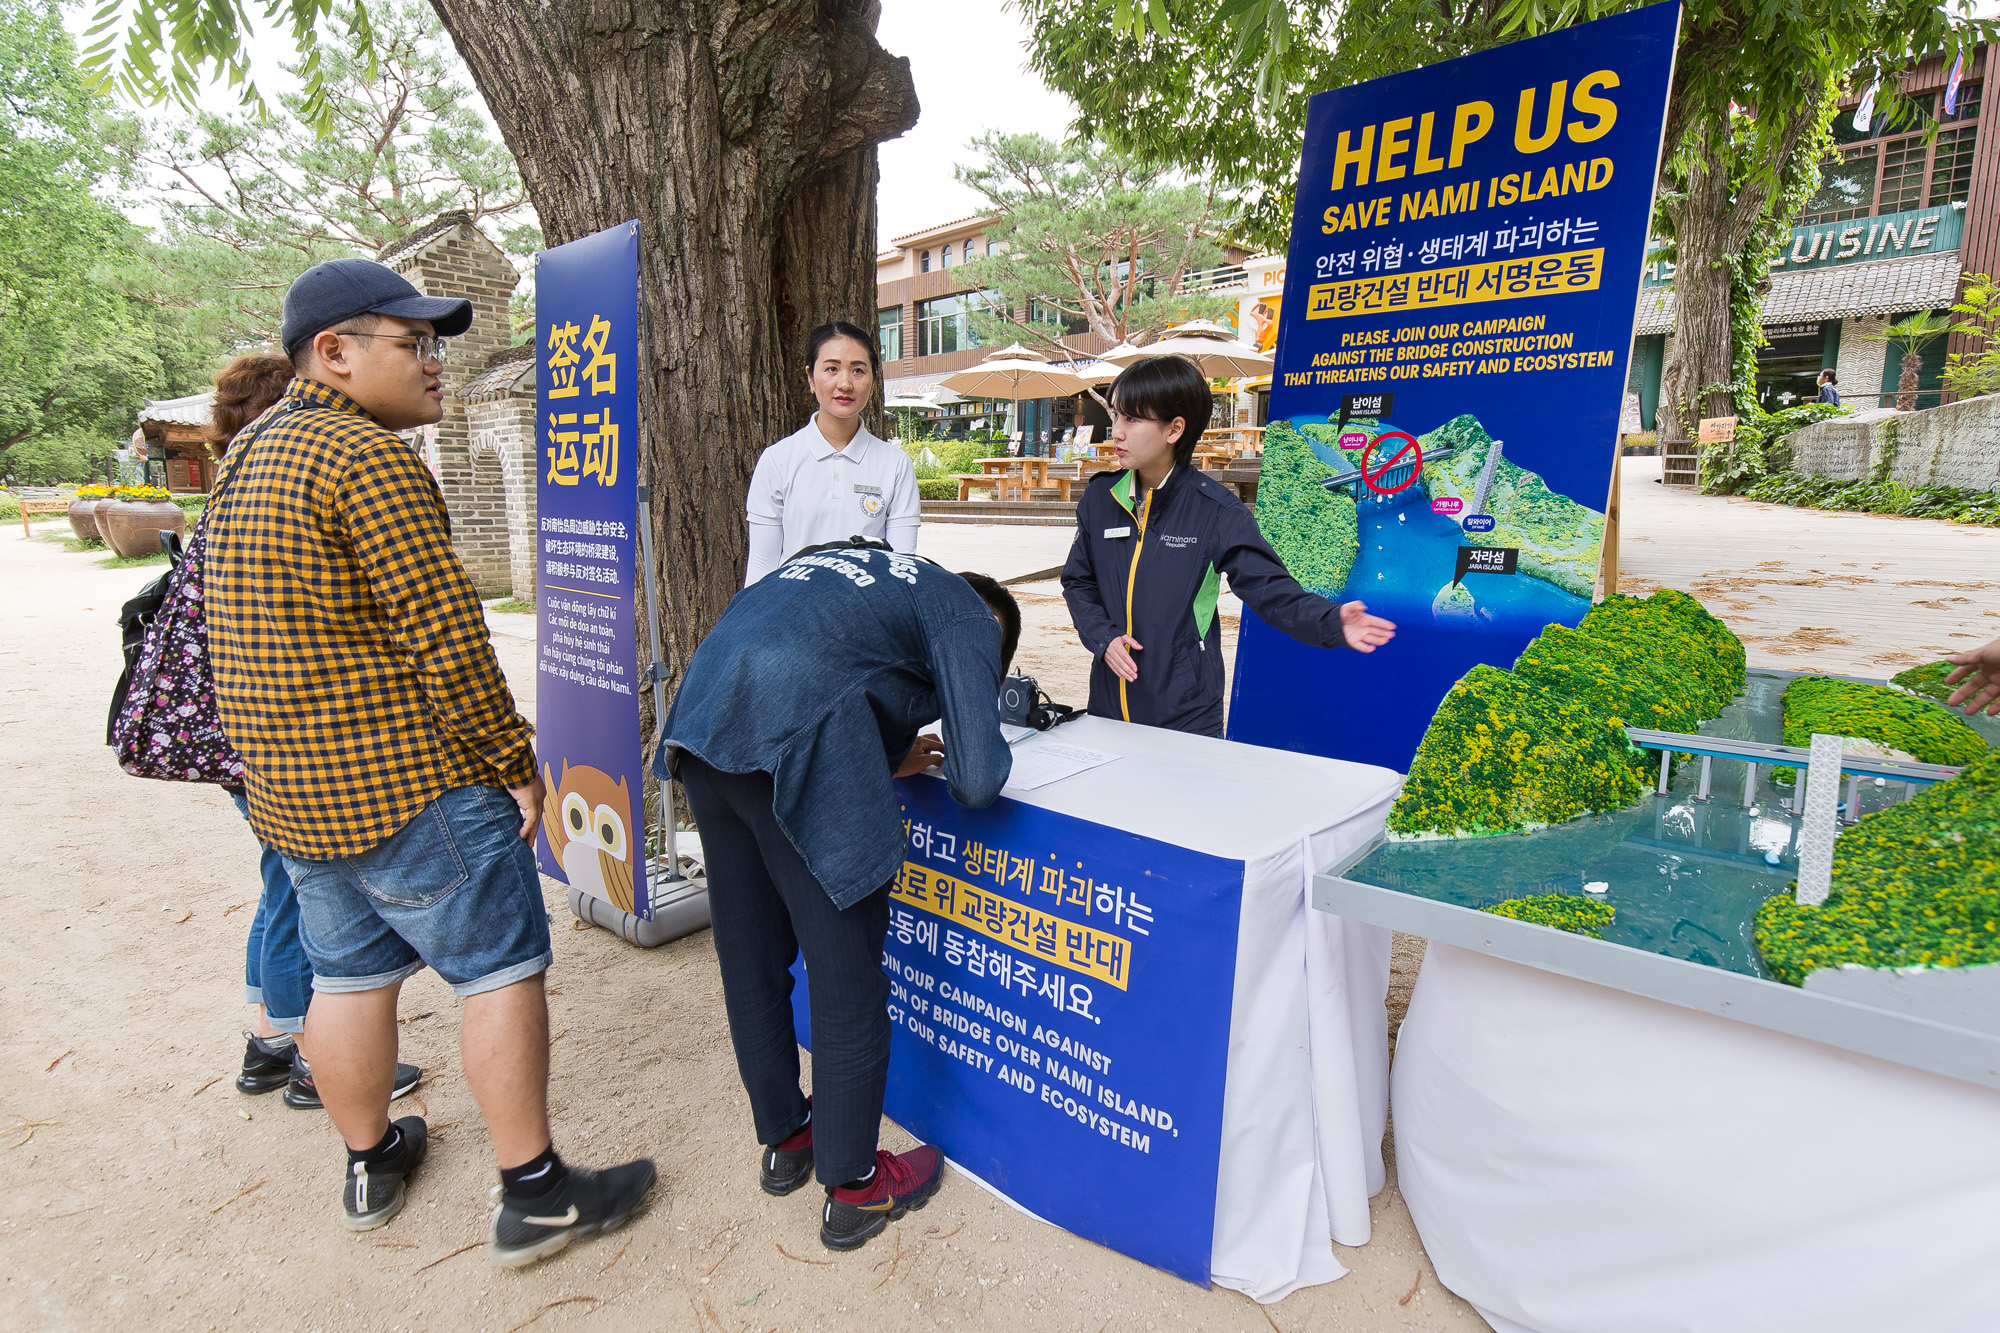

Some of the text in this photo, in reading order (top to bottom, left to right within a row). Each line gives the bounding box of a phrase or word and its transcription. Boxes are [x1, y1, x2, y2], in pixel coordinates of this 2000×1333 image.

[1331, 70, 1620, 190] HELP US
[1322, 157, 1613, 234] SAVE NAMI ISLAND
[1316, 248, 1355, 279] 안전
[1361, 243, 1404, 271] 위협
[1418, 230, 1489, 266] 생태계
[1493, 217, 1599, 253] 파괴하는
[1312, 253, 1596, 312] 교량건설 반대 서명운동
[548, 314, 616, 399] 签名
[1312, 333, 1573, 366] AGAINST THE BRIDGE CONSTRUCTION
[1342, 315, 1545, 346] PLEASE JOIN OUR CAMPAIGN
[1284, 351, 1613, 386] THAT THREATENS OUR SAFETY AND ECOSYSTEM
[1352, 396, 1382, 410] 남이섬
[547, 407, 618, 486] 运动
[1469, 550, 1505, 564] 자라섬
[547, 596, 560, 611] Cuộc
[561, 598, 571, 613] vận
[571, 601, 587, 617] động
[548, 612, 558, 626] Các
[577, 621, 589, 635] dọa
[589, 623, 598, 634] an
[542, 644, 552, 657] Xin
[552, 630, 563, 644] phá
[583, 637, 597, 652] sinh
[597, 639, 610, 655] thái
[610, 679, 632, 696] Nami.
[962, 839, 1034, 895] 생태계
[1040, 862, 1154, 935] 파괴하는
[934, 877, 956, 915] 위
[960, 888, 1058, 958] 교량건설
[1065, 926, 1123, 983] 반대
[943, 929, 1101, 1025] 동참해주세요.
[905, 966, 934, 991] OUR
[939, 981, 1027, 1035] CAMPAIGN
[1030, 1025, 1111, 1078] AGAINST
[909, 1017, 934, 1044] OUR
[939, 1035, 993, 1073] SAFETY
[998, 1065, 1035, 1093] AND
[1040, 1083, 1151, 1154] ECOSYSTEM
[911, 995, 928, 1014] OF
[933, 1004, 991, 1045] BRIDGE
[996, 1035, 1040, 1069] OVER
[1047, 1057, 1092, 1096] NAMI
[1097, 1085, 1179, 1138] ISLAND,
